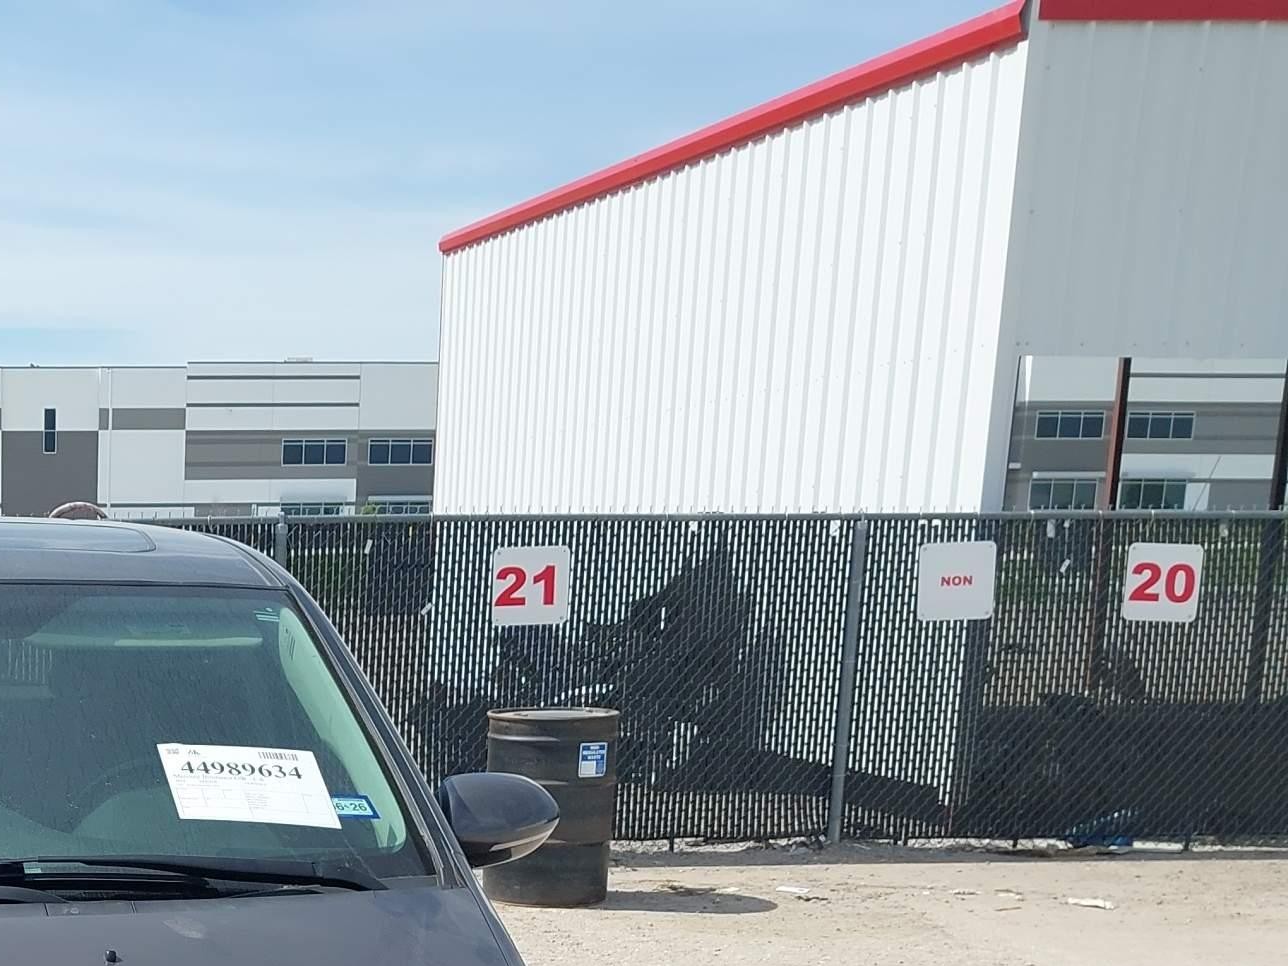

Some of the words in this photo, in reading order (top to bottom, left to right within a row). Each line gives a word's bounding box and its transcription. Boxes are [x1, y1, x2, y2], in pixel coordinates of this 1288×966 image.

[495, 565, 556, 608] 21
[940, 575, 973, 587] NON
[1130, 562, 1196, 604] 20
[180, 760, 304, 780] 44989634
